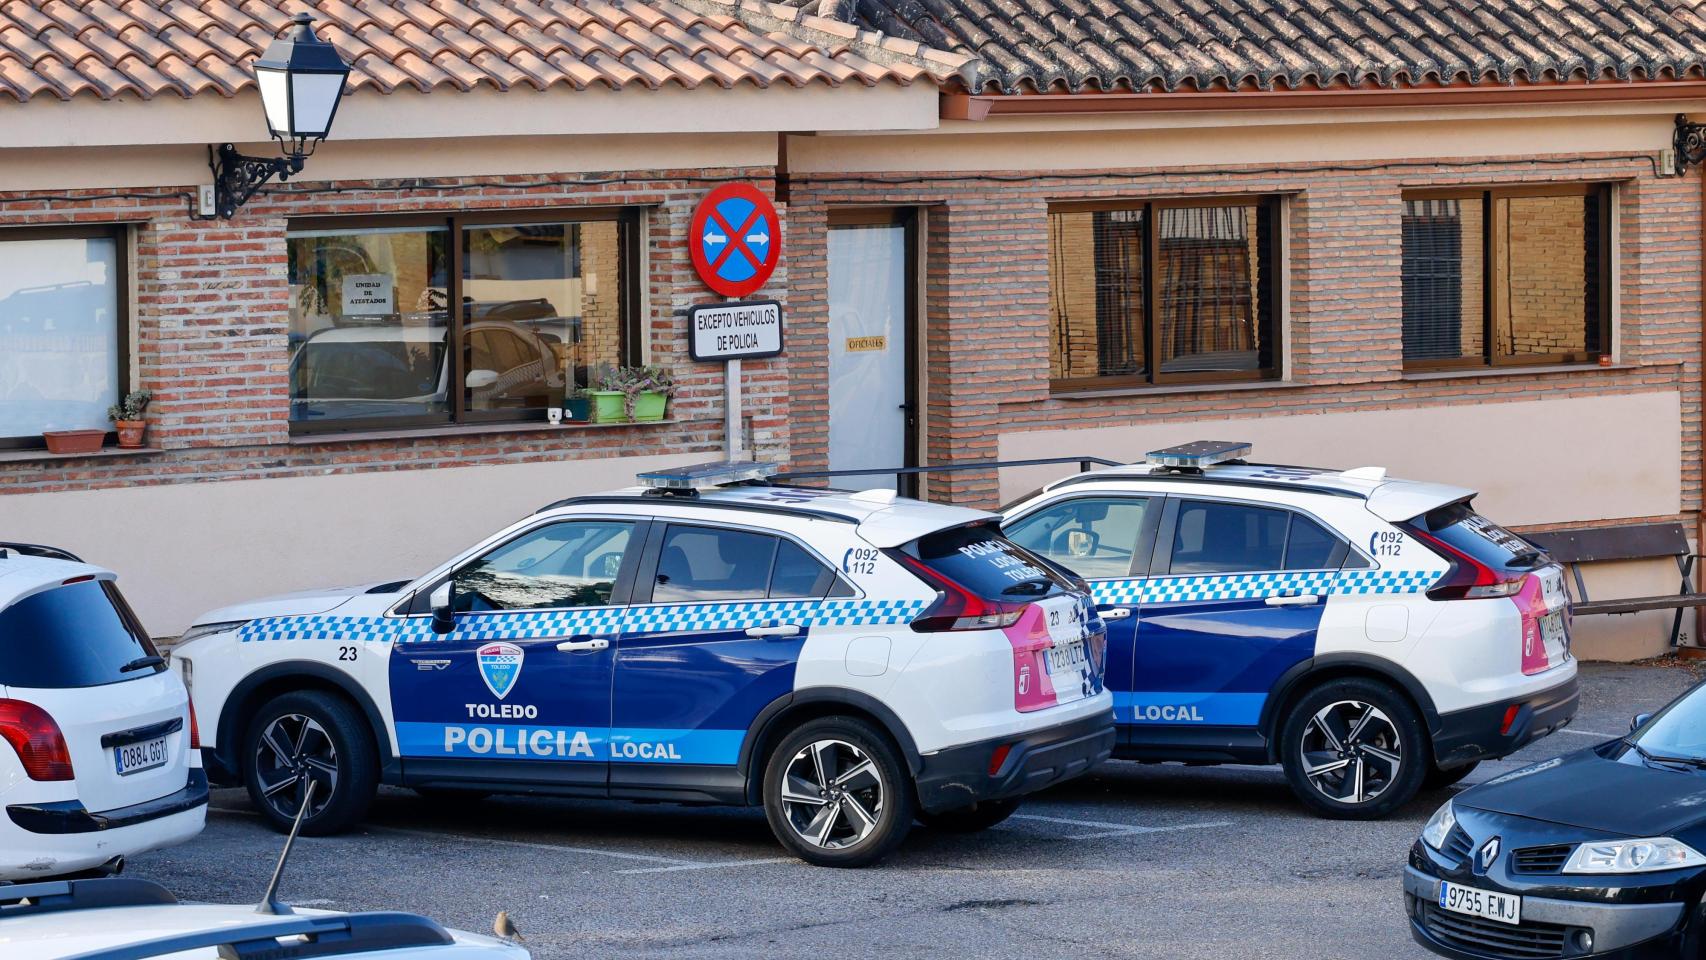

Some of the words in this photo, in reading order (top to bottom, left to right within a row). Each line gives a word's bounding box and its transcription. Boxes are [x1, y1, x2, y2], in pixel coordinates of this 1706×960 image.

[698, 312, 732, 331] EXCEPTO
[733, 308, 775, 327] VEHICULOS
[717, 335, 727, 351] DE
[729, 332, 759, 350] POLICIA
[849, 338, 883, 349] OFICIALES
[1380, 531, 1404, 543] 092
[855, 548, 879, 561] 092
[958, 540, 1015, 559] POLICIA
[1380, 544, 1401, 556] 112
[853, 561, 875, 574] 112
[988, 554, 1028, 569] LOCAL
[1003, 565, 1047, 582] TOLEDO
[1050, 610, 1060, 626] 23
[338, 646, 358, 661] 23
[1050, 648, 1070, 669] 1238
[465, 703, 538, 719] TOLEDO
[1134, 704, 1204, 721] LOCAL
[444, 726, 595, 758] POLICIA
[611, 742, 682, 760] LOCAL
[123, 744, 148, 768] 0884
[150, 740, 166, 761] GGT
[1449, 887, 1482, 913] 9755
